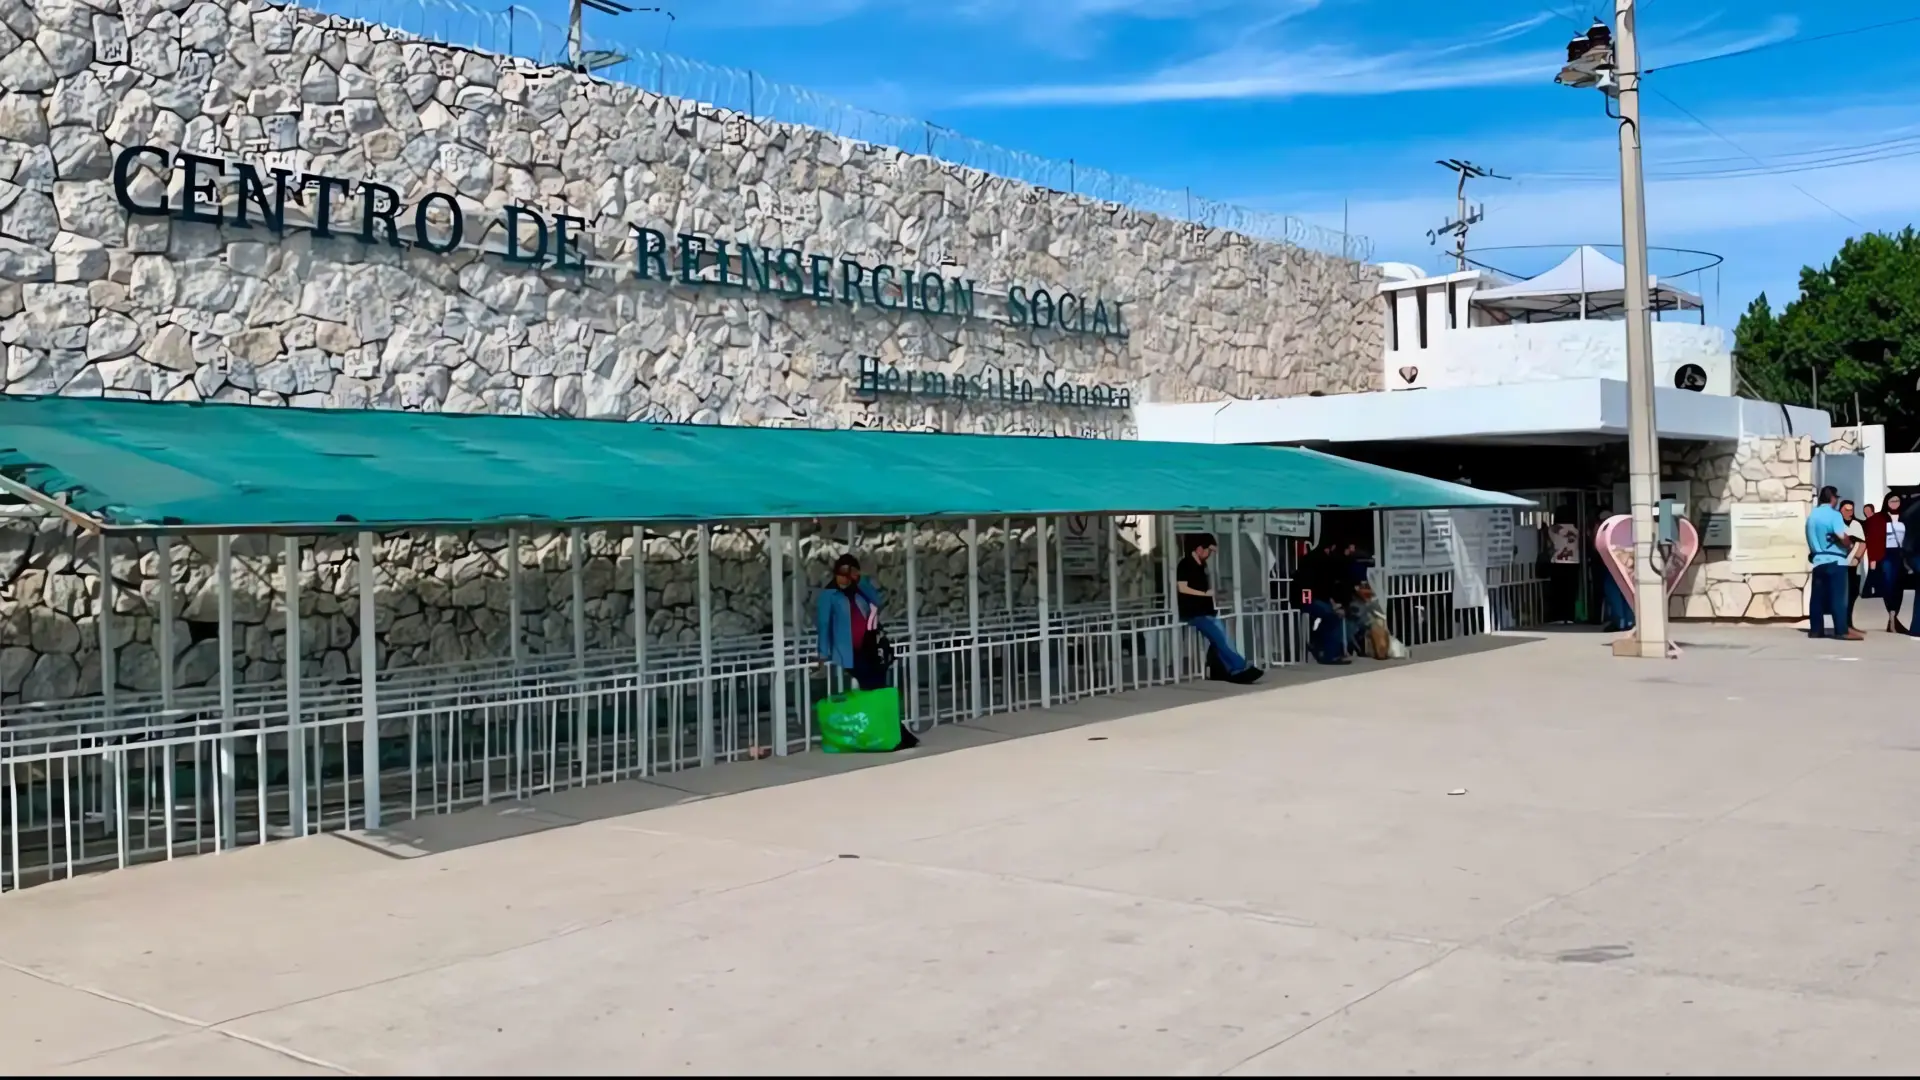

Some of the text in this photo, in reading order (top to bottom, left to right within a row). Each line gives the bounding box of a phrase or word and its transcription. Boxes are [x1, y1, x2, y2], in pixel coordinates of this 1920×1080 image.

[114, 145, 1131, 339] CENTRO DE REINSERCION SOCIAL
[1043, 370, 1130, 409] Sonora
